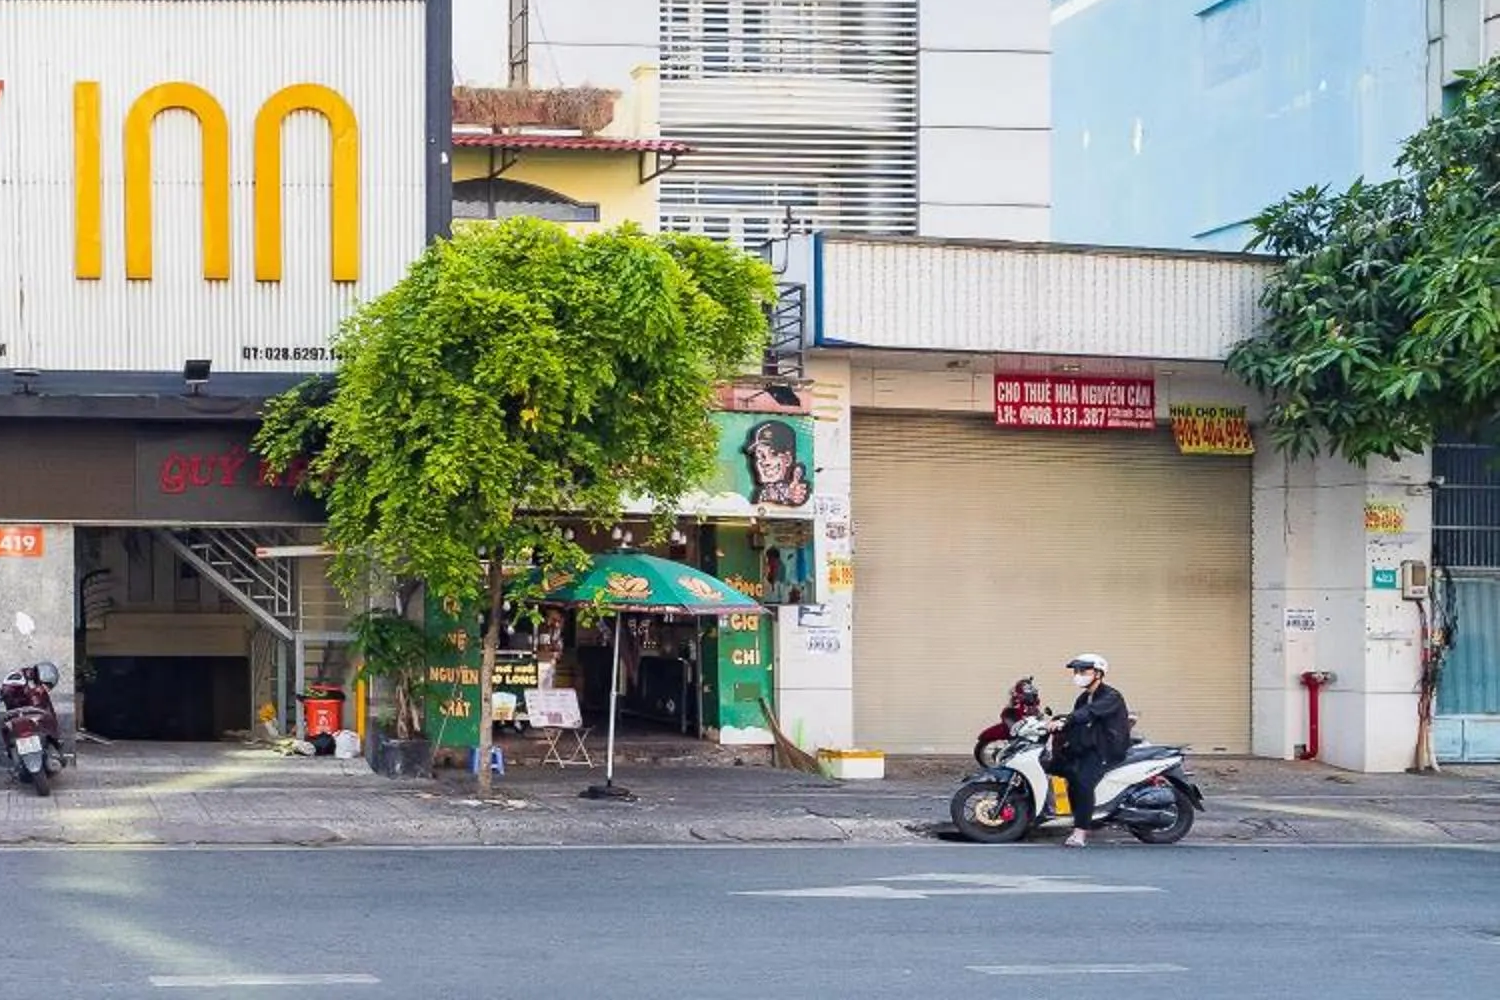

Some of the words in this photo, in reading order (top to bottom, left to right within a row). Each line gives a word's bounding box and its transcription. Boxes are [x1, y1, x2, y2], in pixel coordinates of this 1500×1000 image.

[997, 381, 1022, 402] CHO
[1023, 377, 1052, 403] THUÊ
[1055, 379, 1079, 405] NHÀ
[996, 406, 1017, 424] LH:
[1195, 407, 1217, 418] CHO
[0, 534, 37, 552] 419
